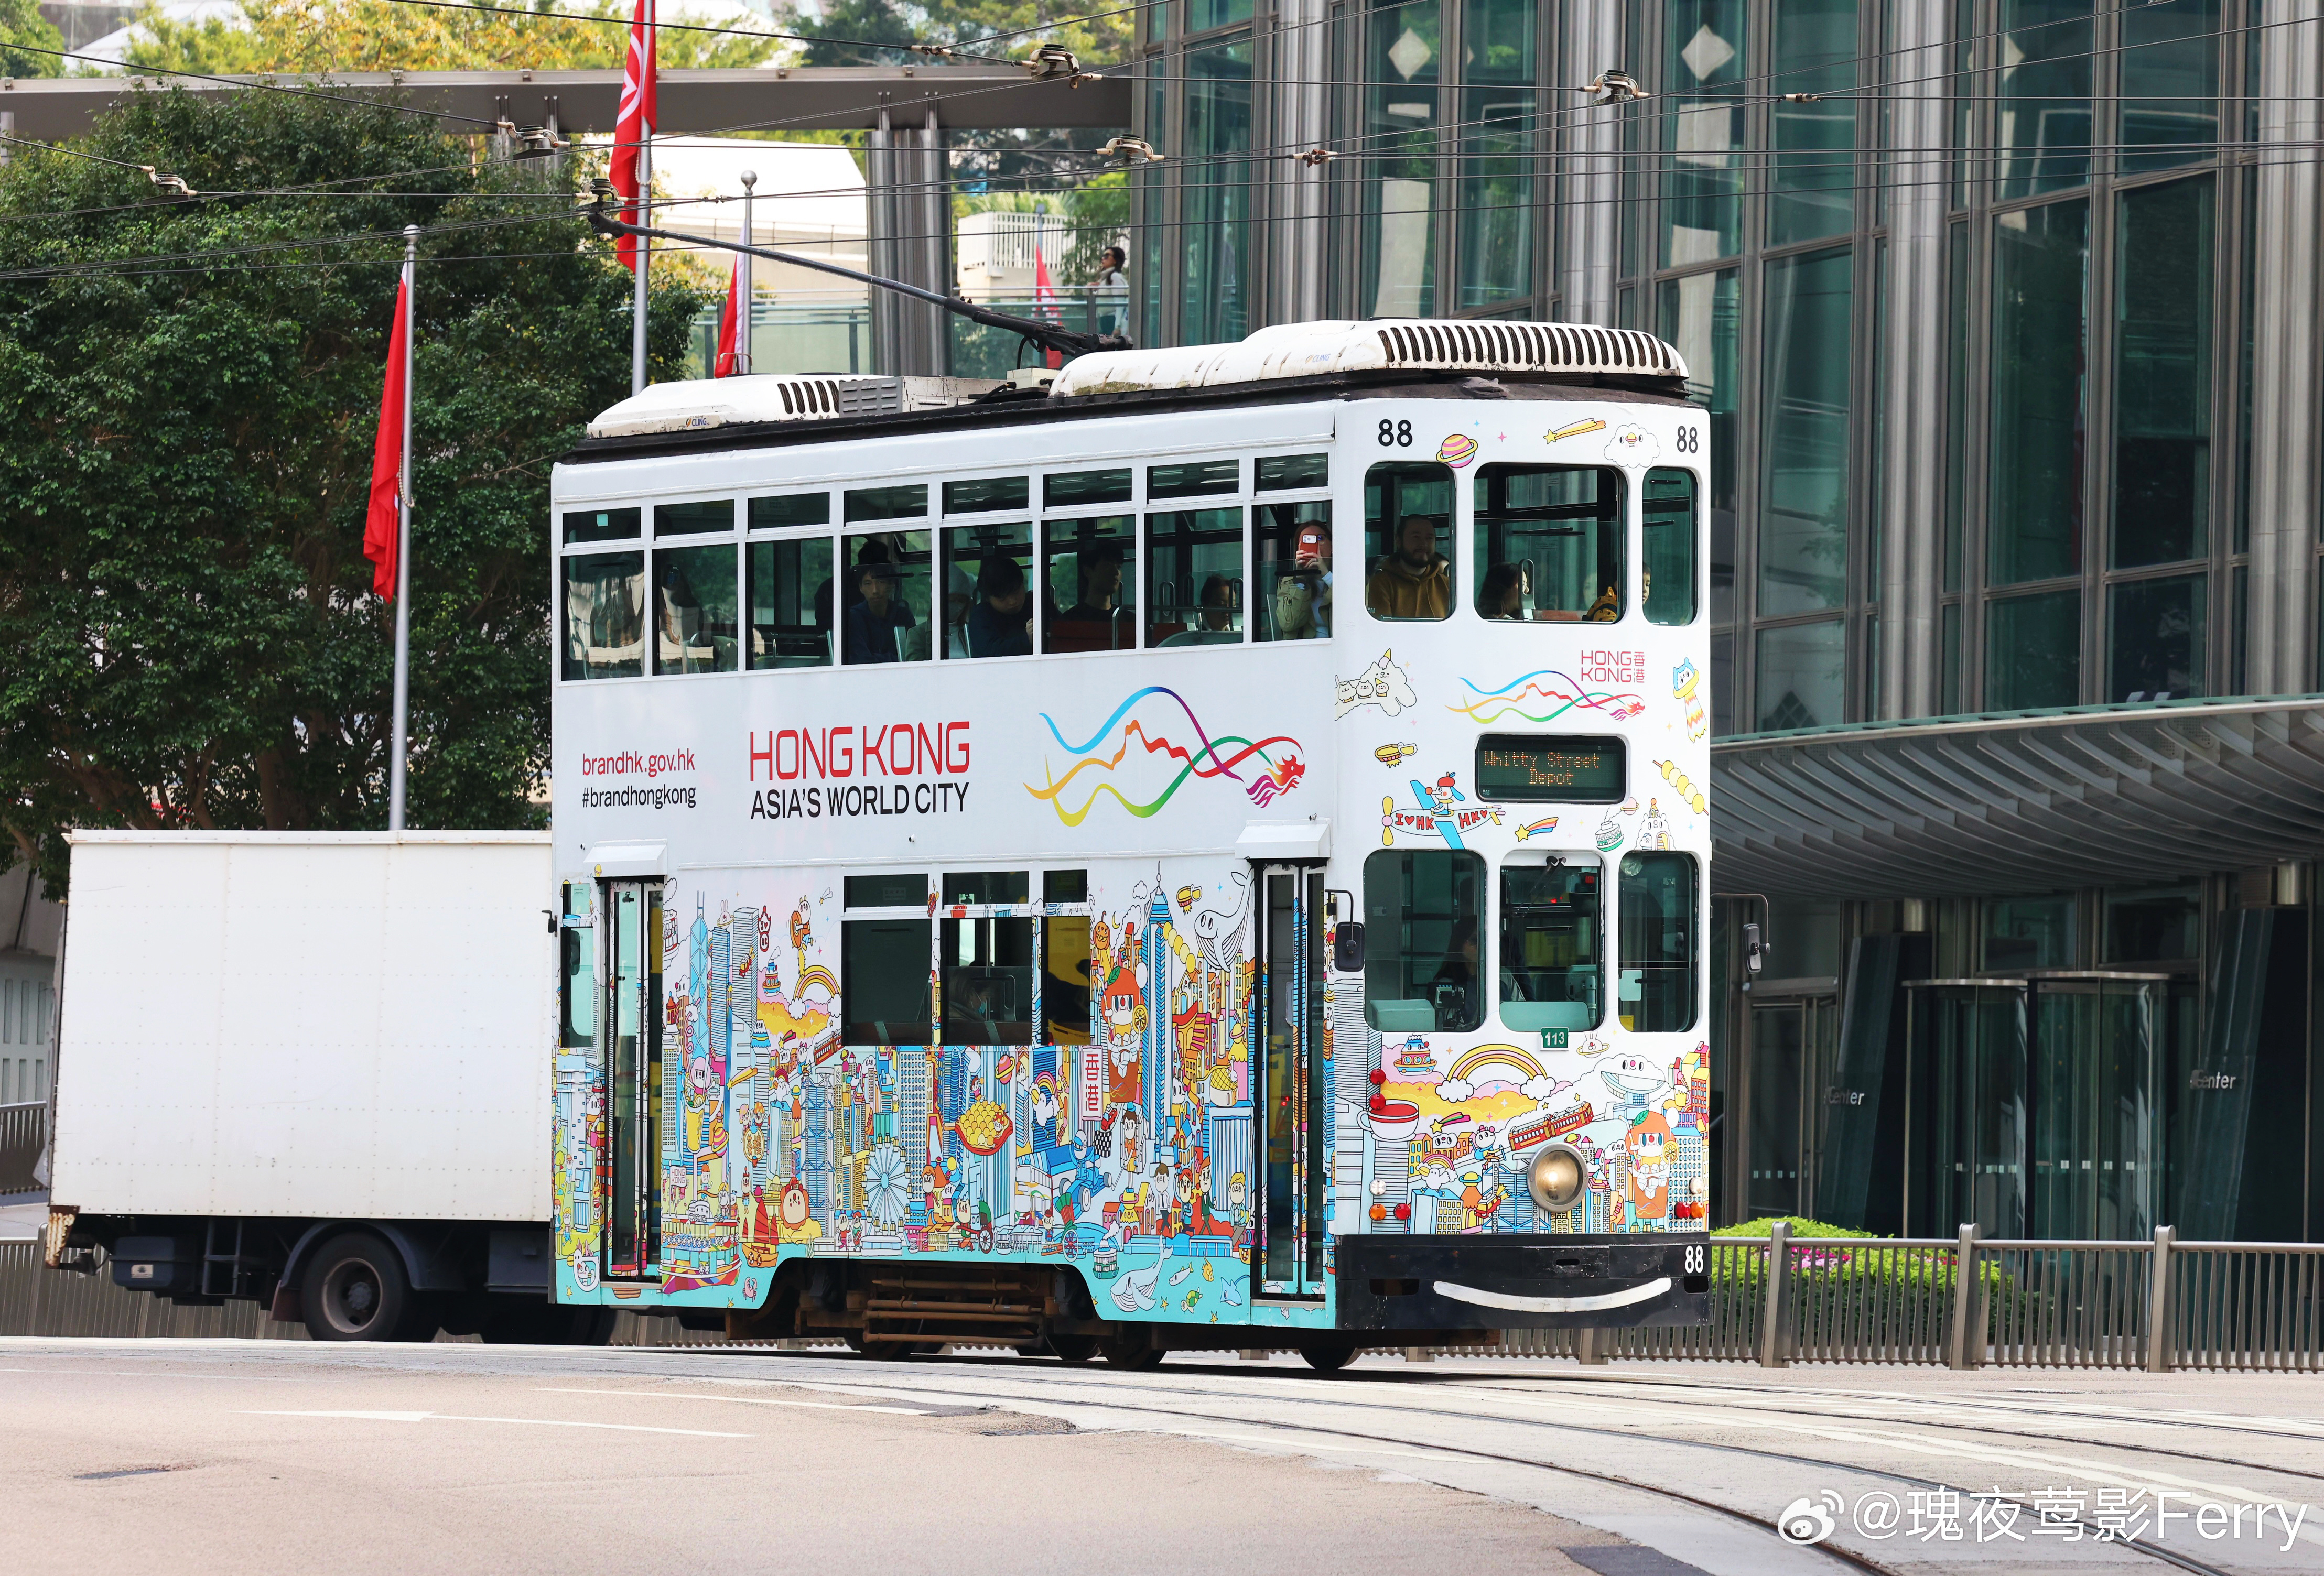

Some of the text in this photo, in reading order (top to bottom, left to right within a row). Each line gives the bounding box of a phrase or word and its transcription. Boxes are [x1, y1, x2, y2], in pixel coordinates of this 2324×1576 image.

[1312, 354, 1331, 363] CLING
[692, 417, 706, 426] CLING
[1378, 419, 1413, 447] 88
[1677, 425, 1699, 454] 88
[1581, 650, 1631, 666] HONG
[1633, 651, 1646, 683] 香港
[1581, 667, 1631, 683] KONG
[750, 721, 970, 781] HONG KONG
[1484, 751, 1600, 768] Whitty Street
[582, 748, 696, 778] brandhk.gov.hk
[1529, 768, 1574, 787] Depot
[582, 784, 696, 810] #brandhongkong
[750, 782, 970, 820] ASIA'S WORLD CITY
[1395, 813, 1434, 830] I HK
[1458, 811, 1480, 829] HK
[1545, 1031, 1565, 1046] 113
[1085, 1053, 1100, 1111] 香港
[1684, 1245, 1704, 1274] 88
